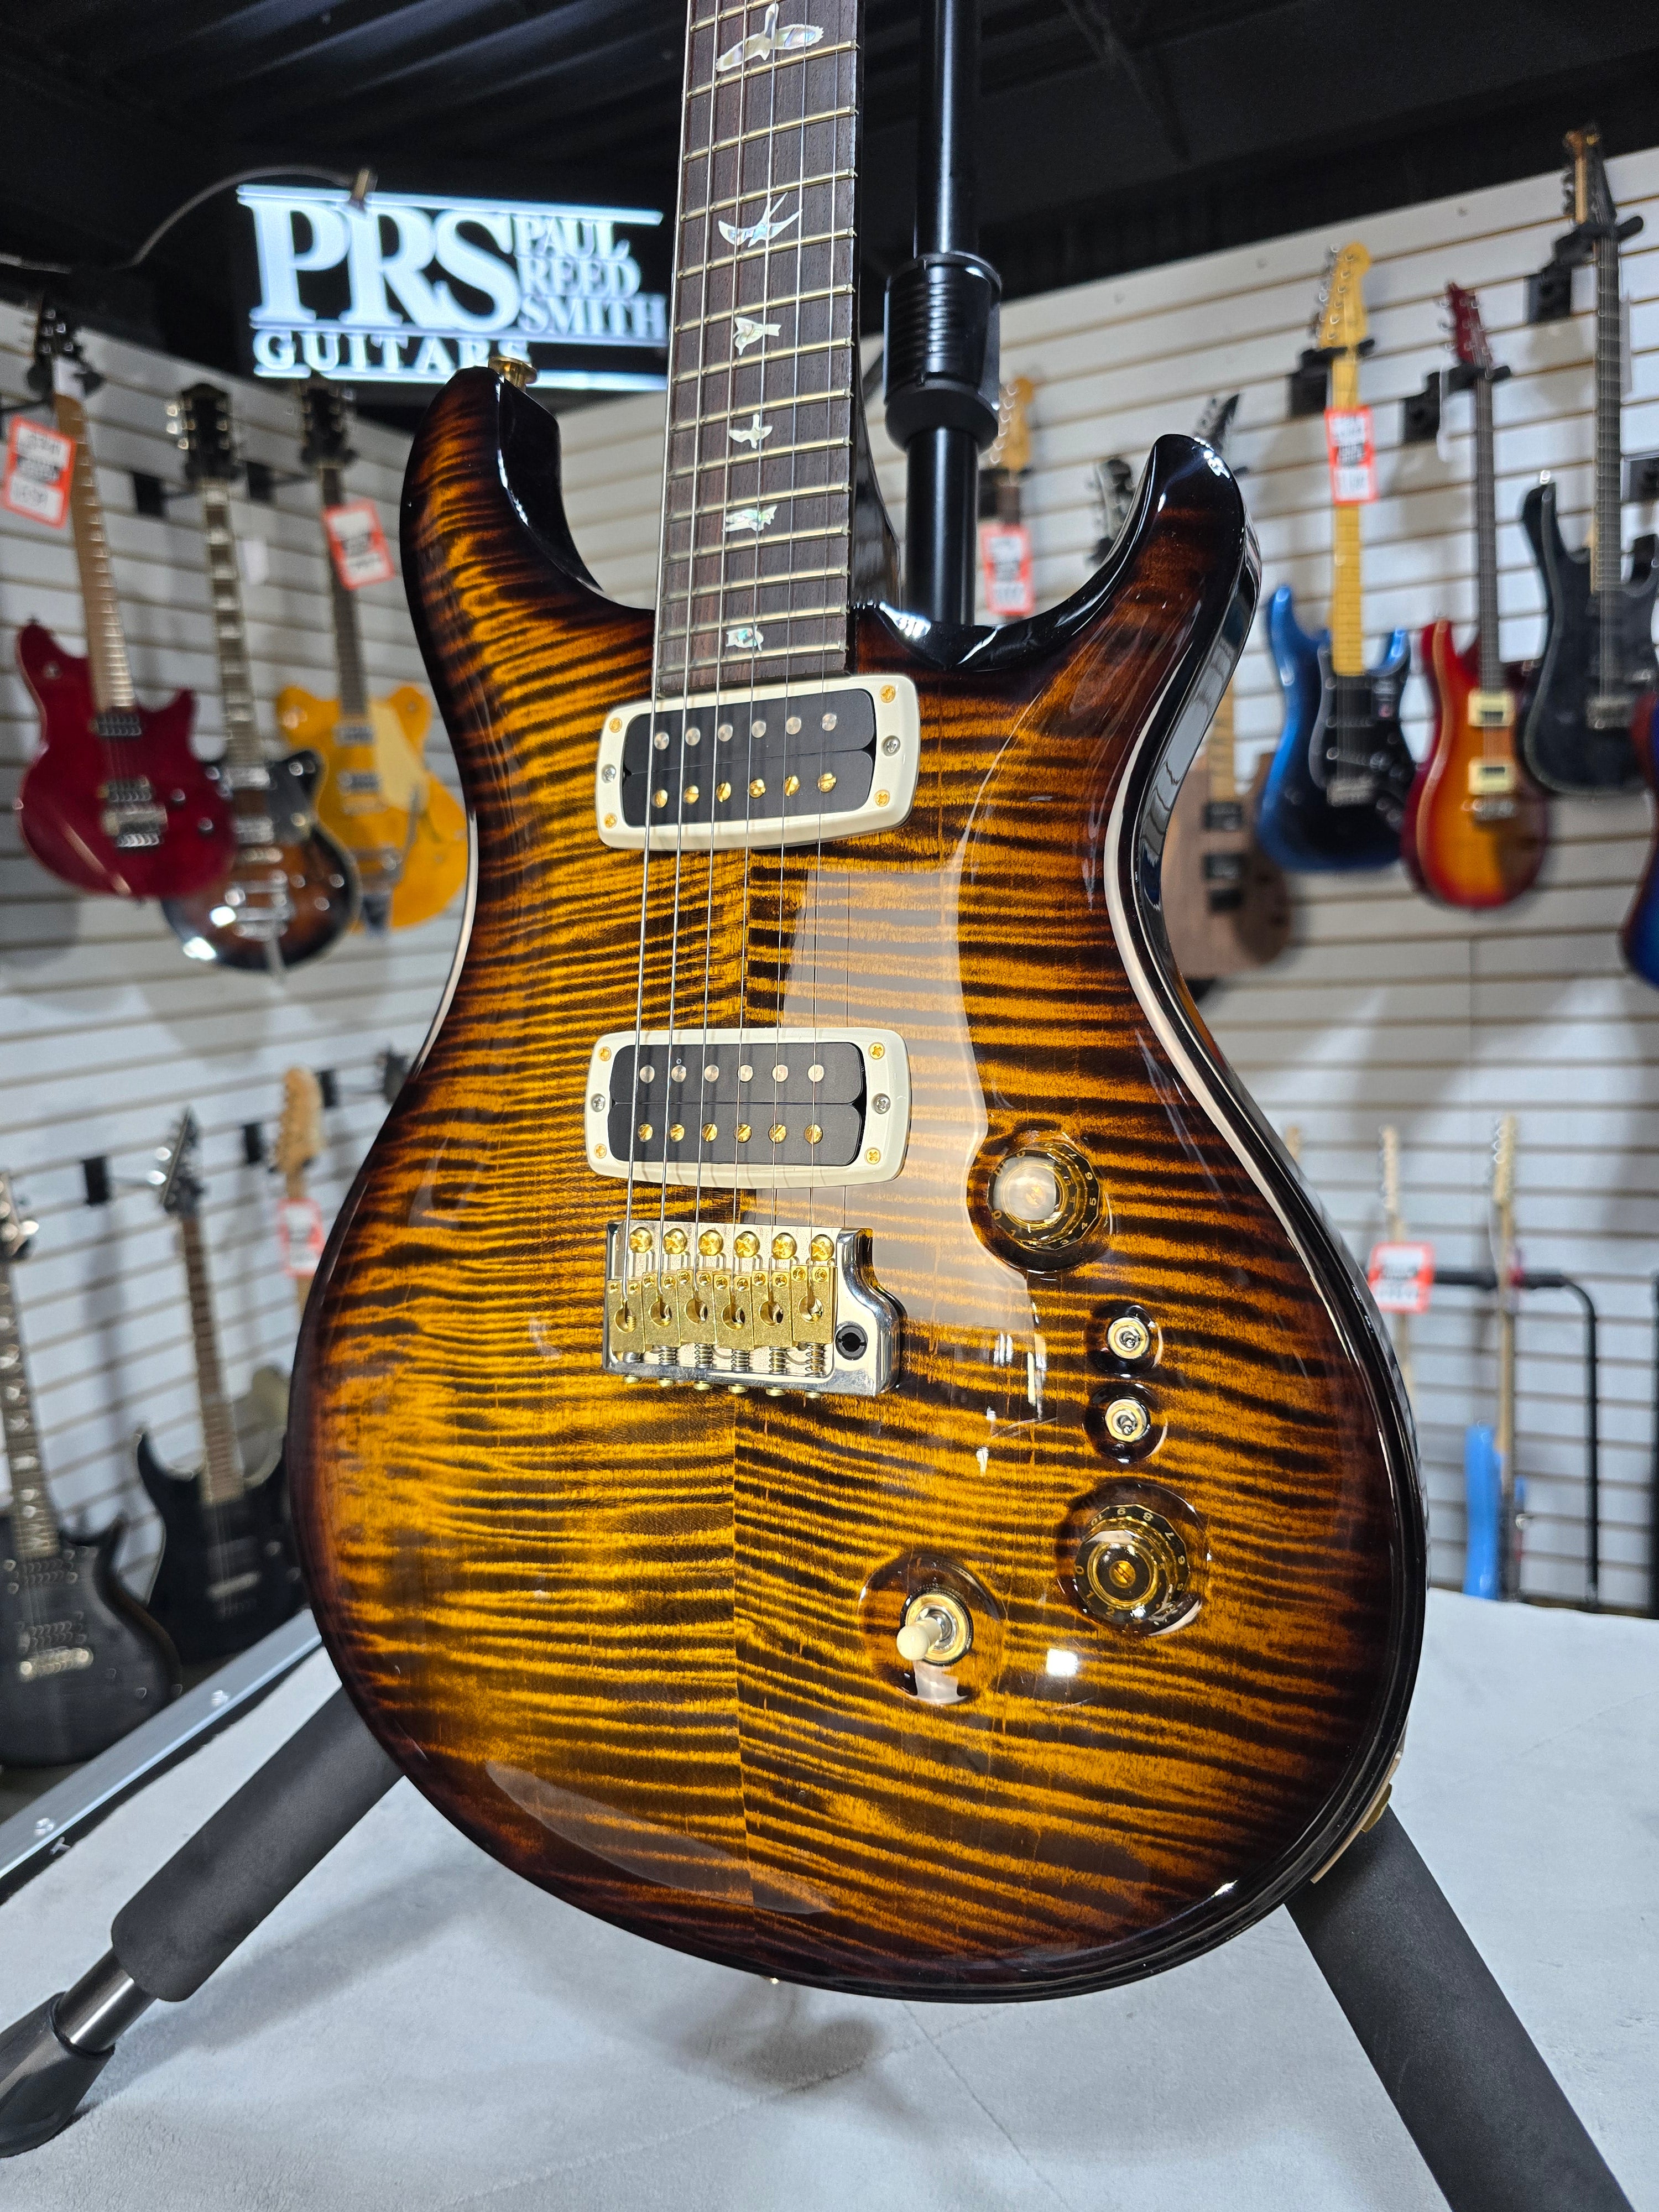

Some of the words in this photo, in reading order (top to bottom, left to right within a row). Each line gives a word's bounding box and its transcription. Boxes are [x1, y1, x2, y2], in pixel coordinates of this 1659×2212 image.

[513, 216, 630, 260] PAUL
[238, 198, 523, 332] PRS
[517, 255, 641, 300] REED
[518, 293, 666, 339] SMITH
[1142, 1512, 1154, 1521] 8
